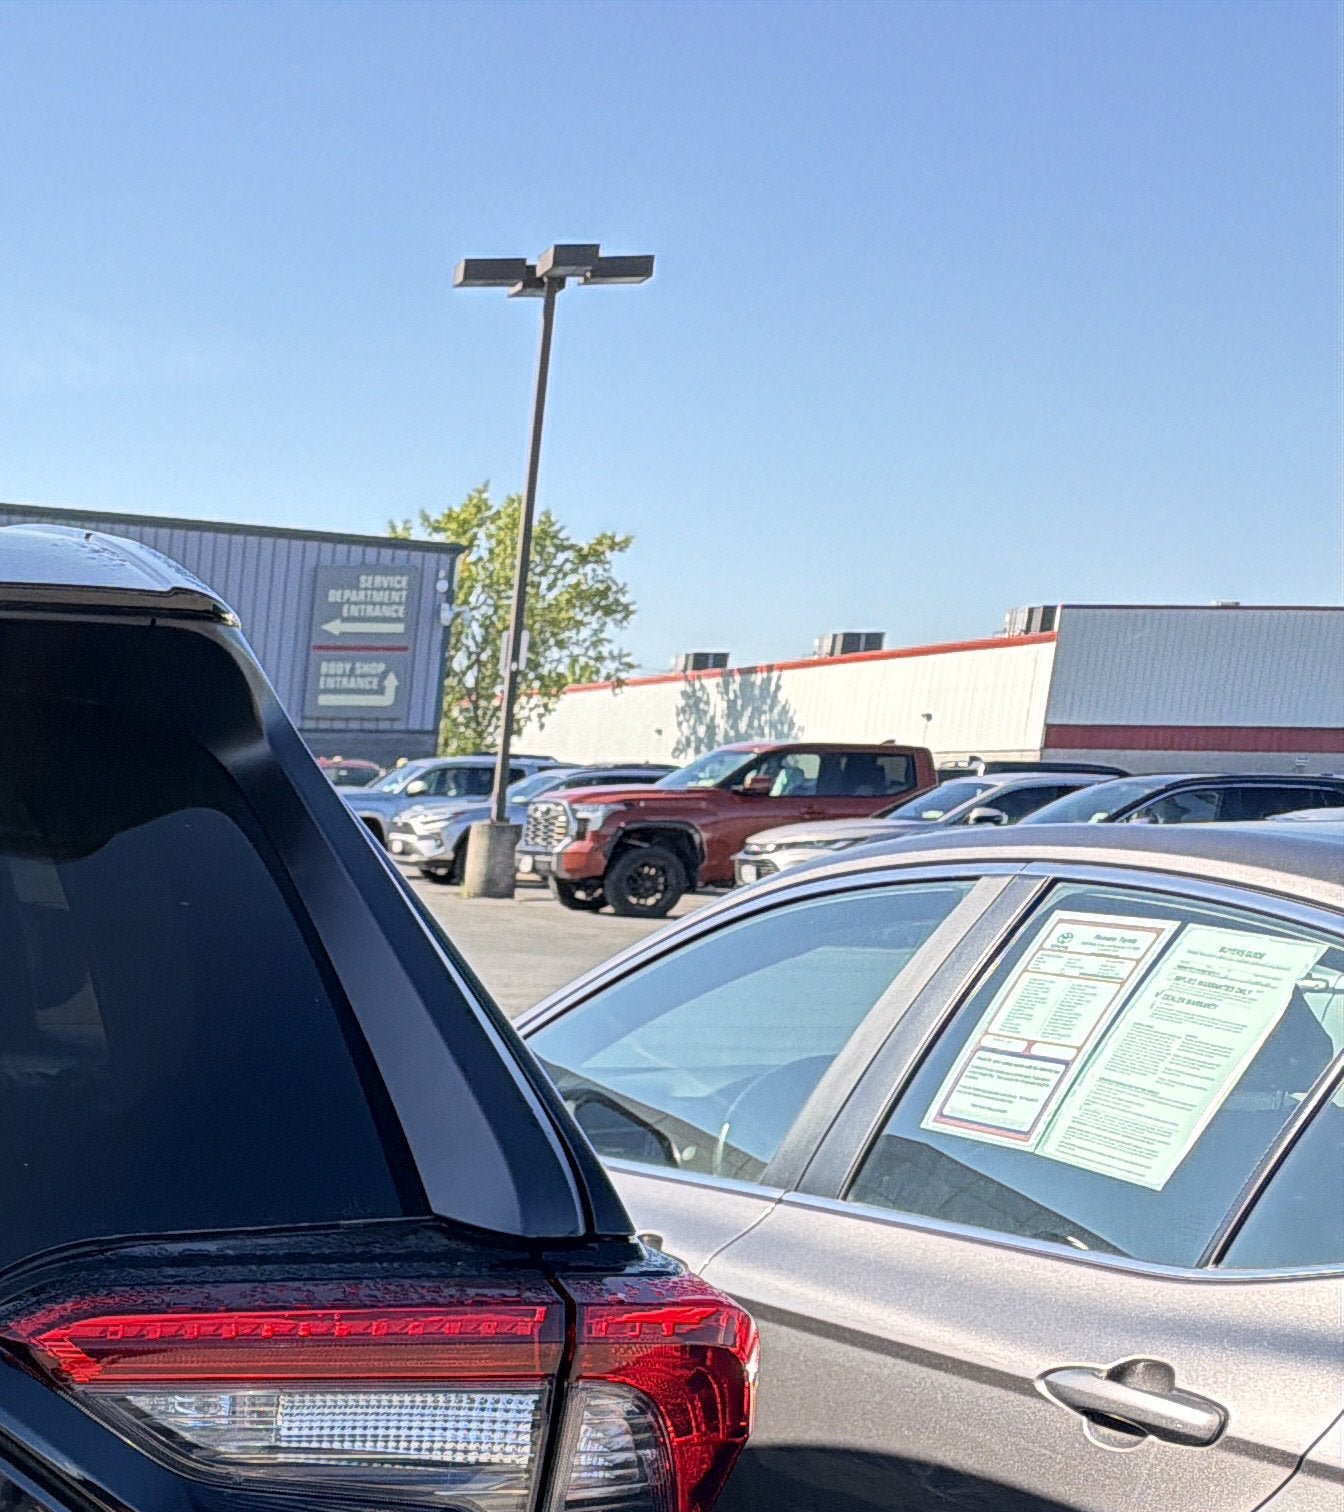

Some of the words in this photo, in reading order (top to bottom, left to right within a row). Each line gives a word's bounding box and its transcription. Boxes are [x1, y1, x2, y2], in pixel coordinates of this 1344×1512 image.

[359, 575, 408, 588] SERVICE
[328, 589, 408, 602] DEPARTMENT
[342, 604, 406, 617] ENTRANCE
[320, 661, 352, 674] BODY
[354, 662, 386, 674] SHOP
[319, 676, 379, 689] ENTRANCE
